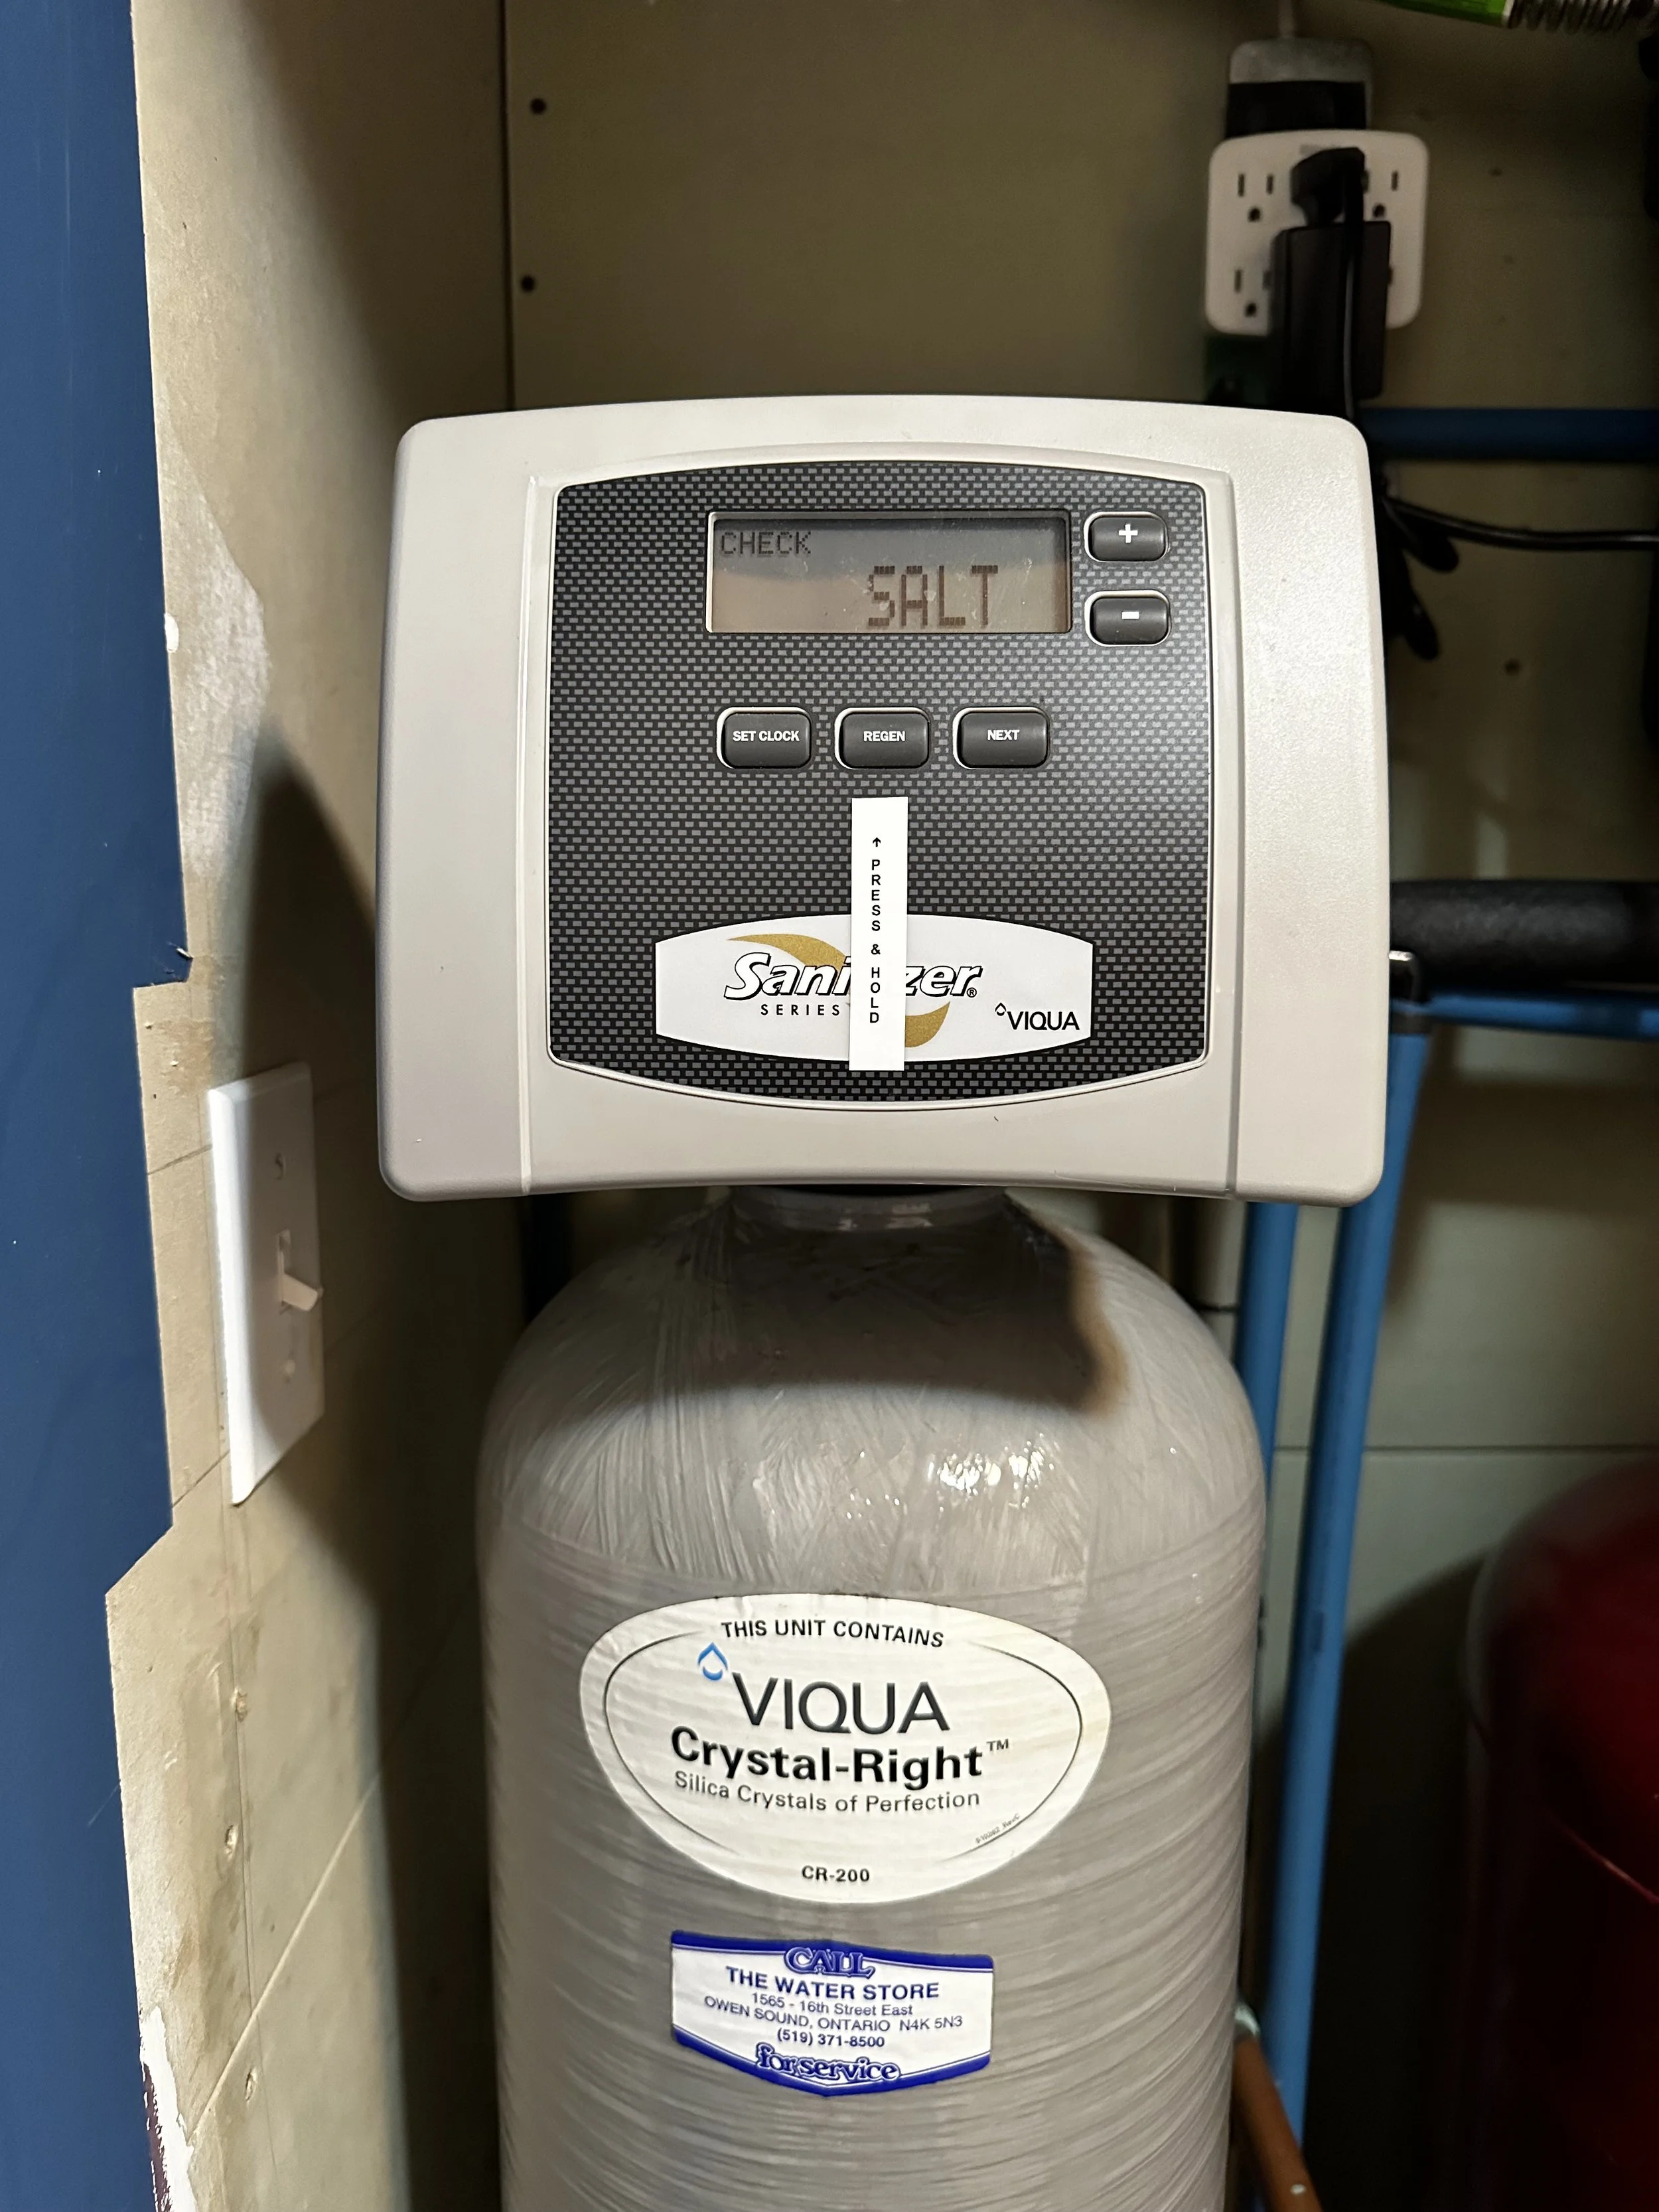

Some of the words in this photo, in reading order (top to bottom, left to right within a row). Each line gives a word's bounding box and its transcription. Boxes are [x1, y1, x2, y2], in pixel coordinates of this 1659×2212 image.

[720, 531, 812, 555] CHECK
[867, 565, 999, 627] SALT
[732, 731, 757, 742] SET
[758, 731, 800, 742] CLOCK
[863, 731, 906, 743] REGEN
[987, 729, 1019, 741] NEXT
[871, 859, 882, 932] PRESS
[870, 943, 882, 955] &
[869, 967, 881, 1024] HOLD
[760, 1003, 840, 1017] SERIES
[1008, 1010, 1080, 1031] VIQUA
[721, 1621, 768, 1637] THIS
[775, 1621, 826, 1637] UNIT
[833, 1621, 945, 1647] CONTAINS
[731, 1672, 950, 1735] VIQUA
[675, 1771, 730, 1799] Silica
[737, 1785, 828, 1812] Crystals
[835, 1794, 861, 1812] of
[866, 1790, 980, 1812] Perfection
[802, 1866, 871, 1883] CR-200
[785, 1947, 875, 1978] CALL
[726, 1966, 768, 1988] THE
[774, 1976, 855, 1999] WATER
[863, 1982, 940, 2000] STORE
[705, 1996, 750, 2016] OWEN
[755, 2008, 813, 2029] SOUND,
[818, 2018, 890, 2031] ONTARIO
[900, 2017, 930, 2031] N4K
[934, 2016, 963, 2029] 5N3
[752, 1994, 785, 2008] 1565
[800, 2002, 830, 2014] 16th
[834, 2003, 876, 2016] Street
[881, 2004, 912, 2016] East
[778, 2028, 813, 2046] (519)
[818, 2033, 885, 2047] 371-8500
[756, 2043, 800, 2072] for
[798, 2057, 901, 2081] service
